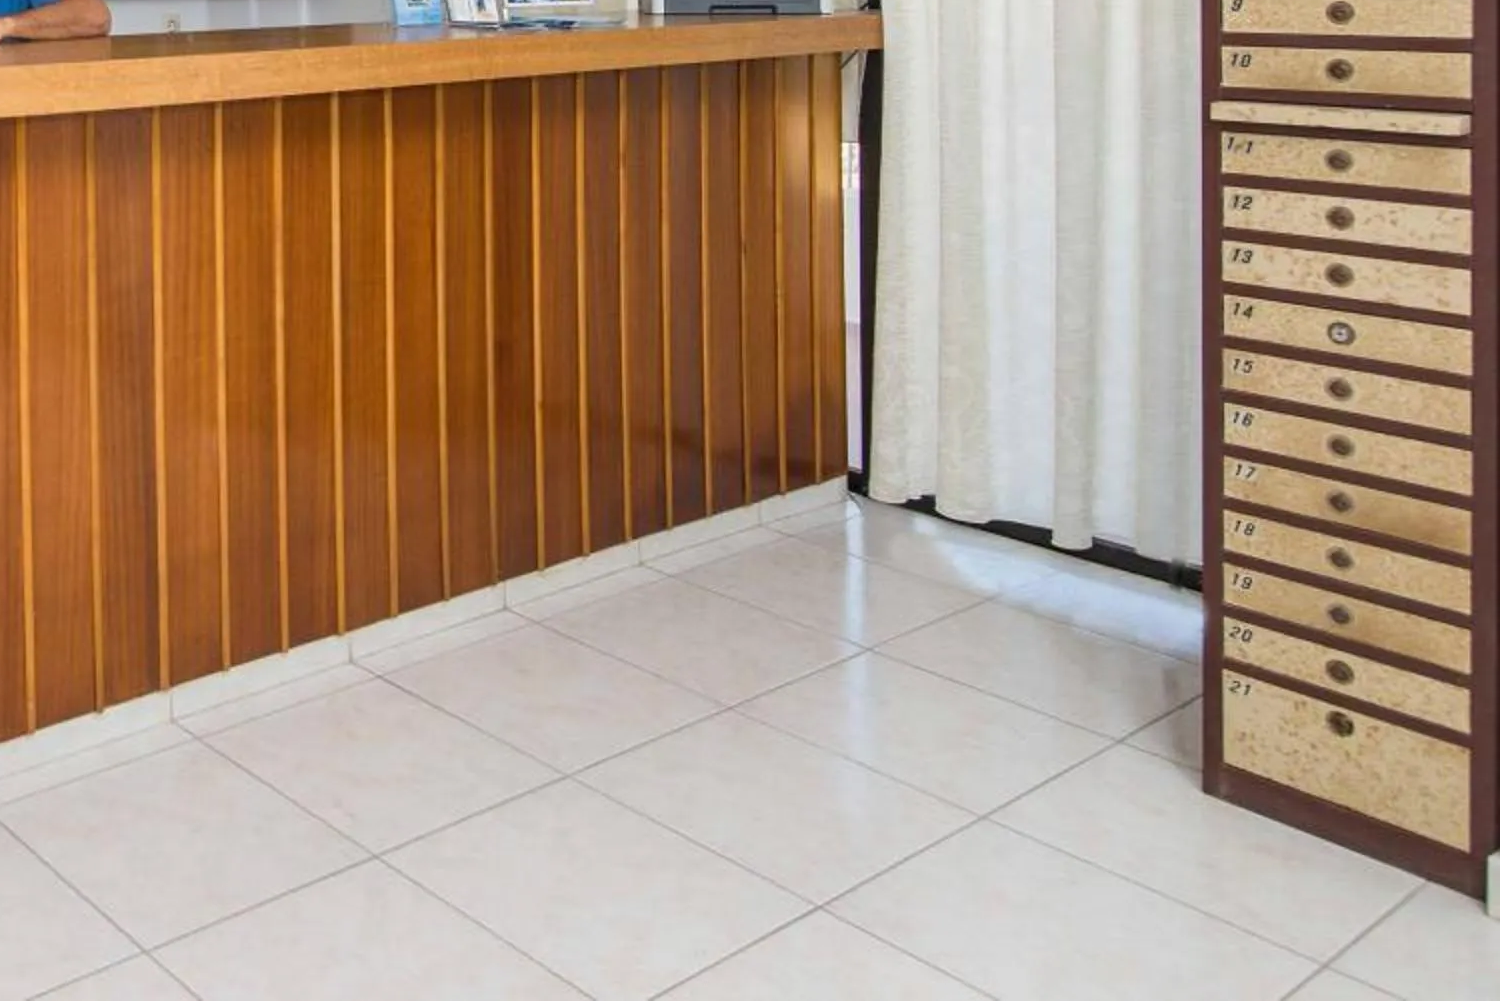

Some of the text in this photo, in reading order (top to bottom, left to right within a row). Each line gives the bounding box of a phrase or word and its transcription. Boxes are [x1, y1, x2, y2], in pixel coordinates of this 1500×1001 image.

[1231, 52, 1252, 68] 10
[1232, 194, 1253, 211] 12
[1231, 247, 1253, 264] 13
[1233, 302, 1254, 319] 14
[1232, 358, 1253, 374] 15
[1232, 410, 1254, 428] 16
[1235, 463, 1257, 479] 17
[1233, 519, 1256, 537] 18
[1232, 572, 1253, 590] 19
[1228, 625, 1254, 643] 20
[1229, 680, 1252, 696] 21
